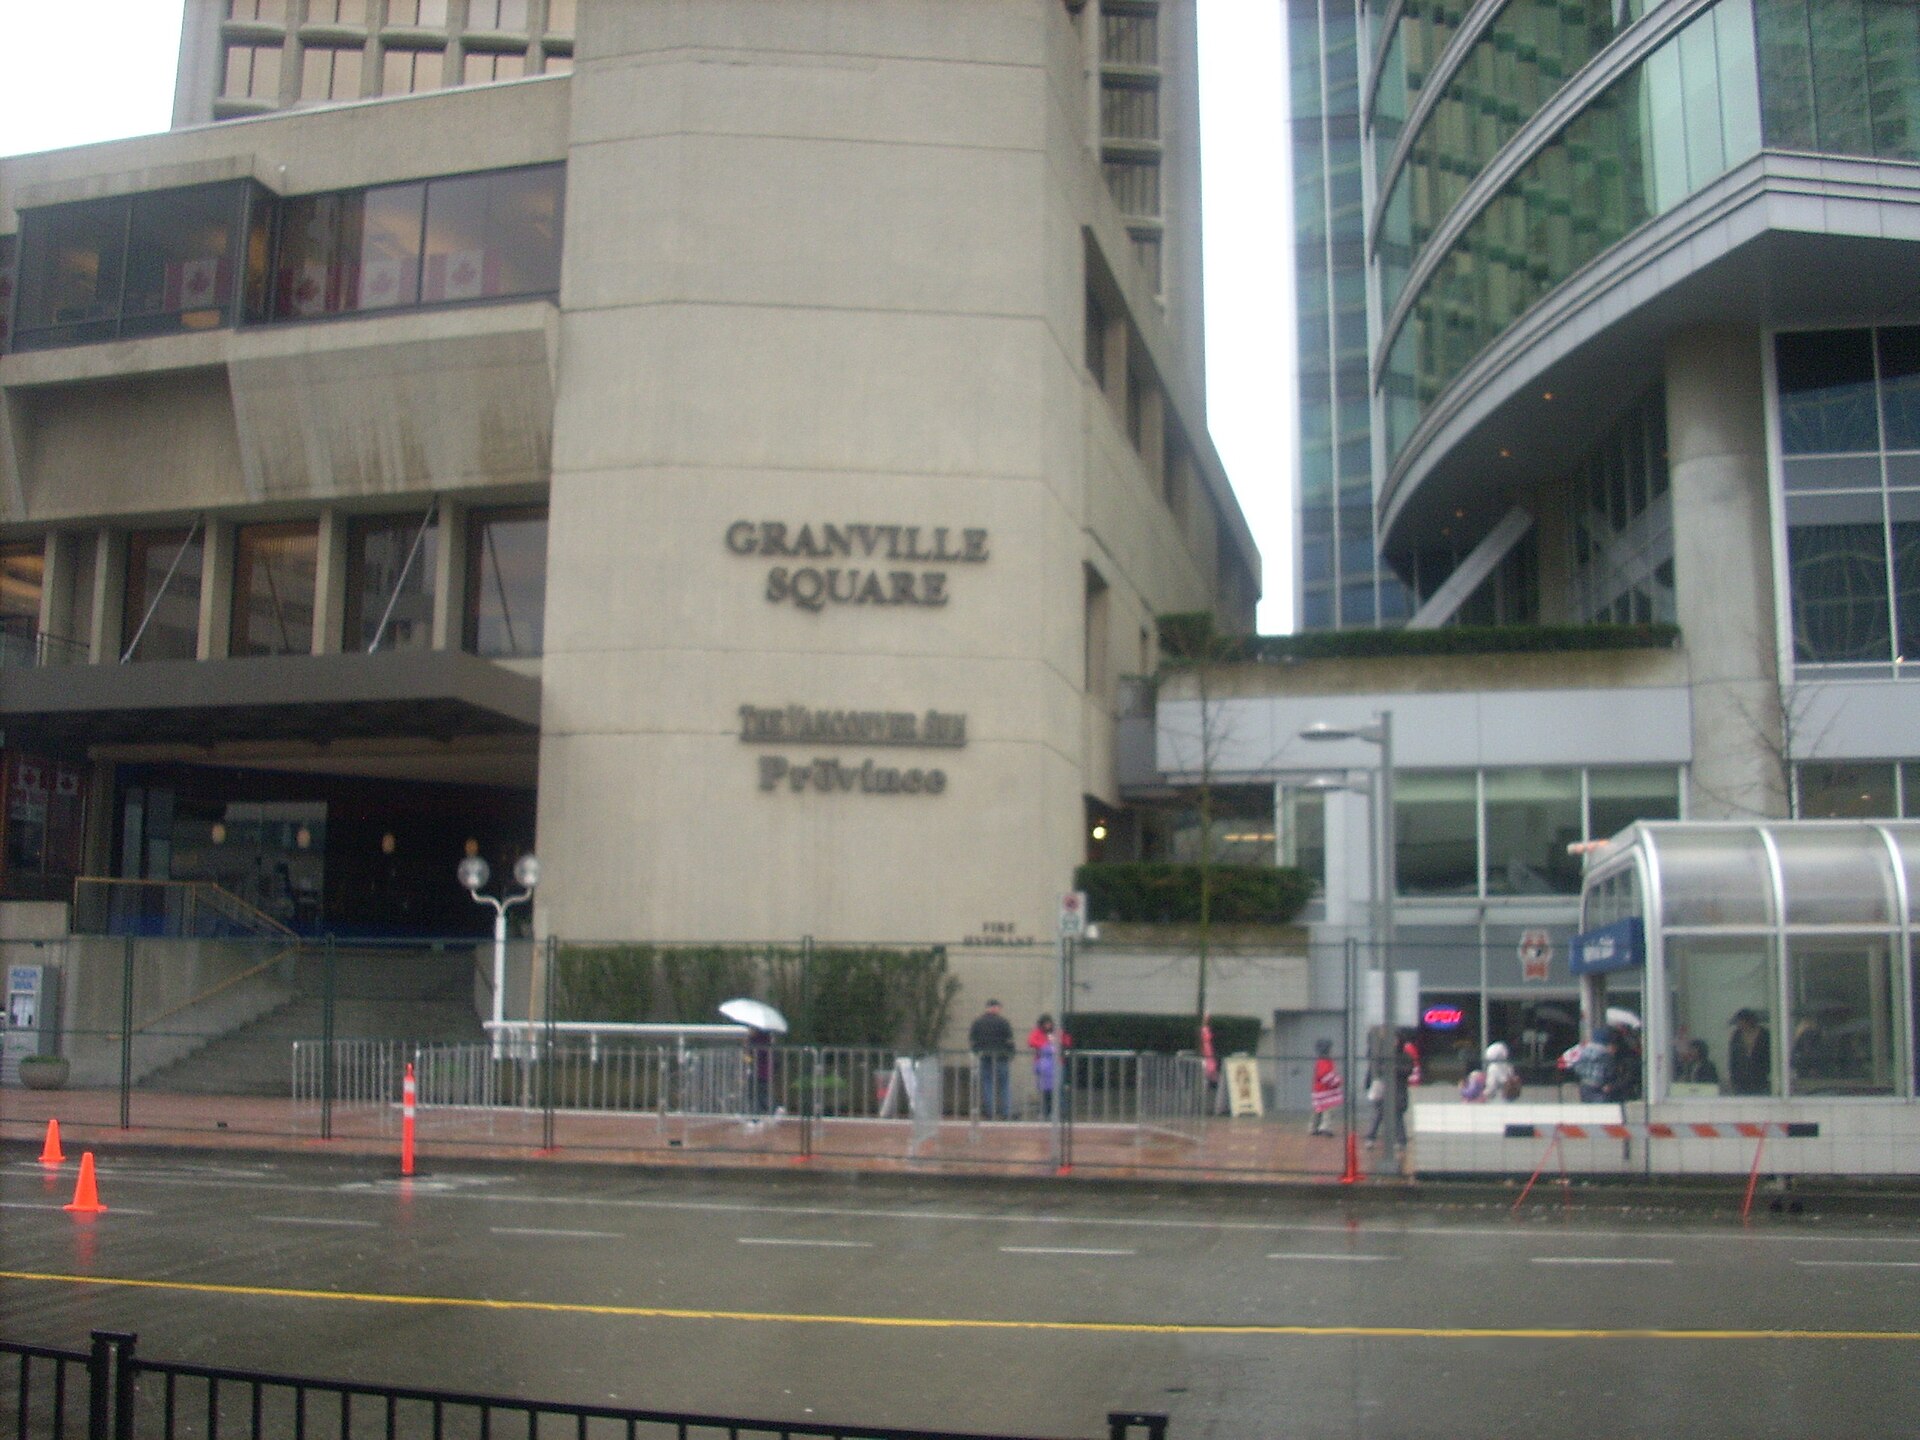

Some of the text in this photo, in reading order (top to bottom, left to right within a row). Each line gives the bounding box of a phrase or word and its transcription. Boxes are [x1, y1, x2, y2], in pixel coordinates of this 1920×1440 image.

[726, 520, 989, 562] GRANVILLE
[765, 566, 948, 612] SQUARE
[757, 755, 948, 794] Province
